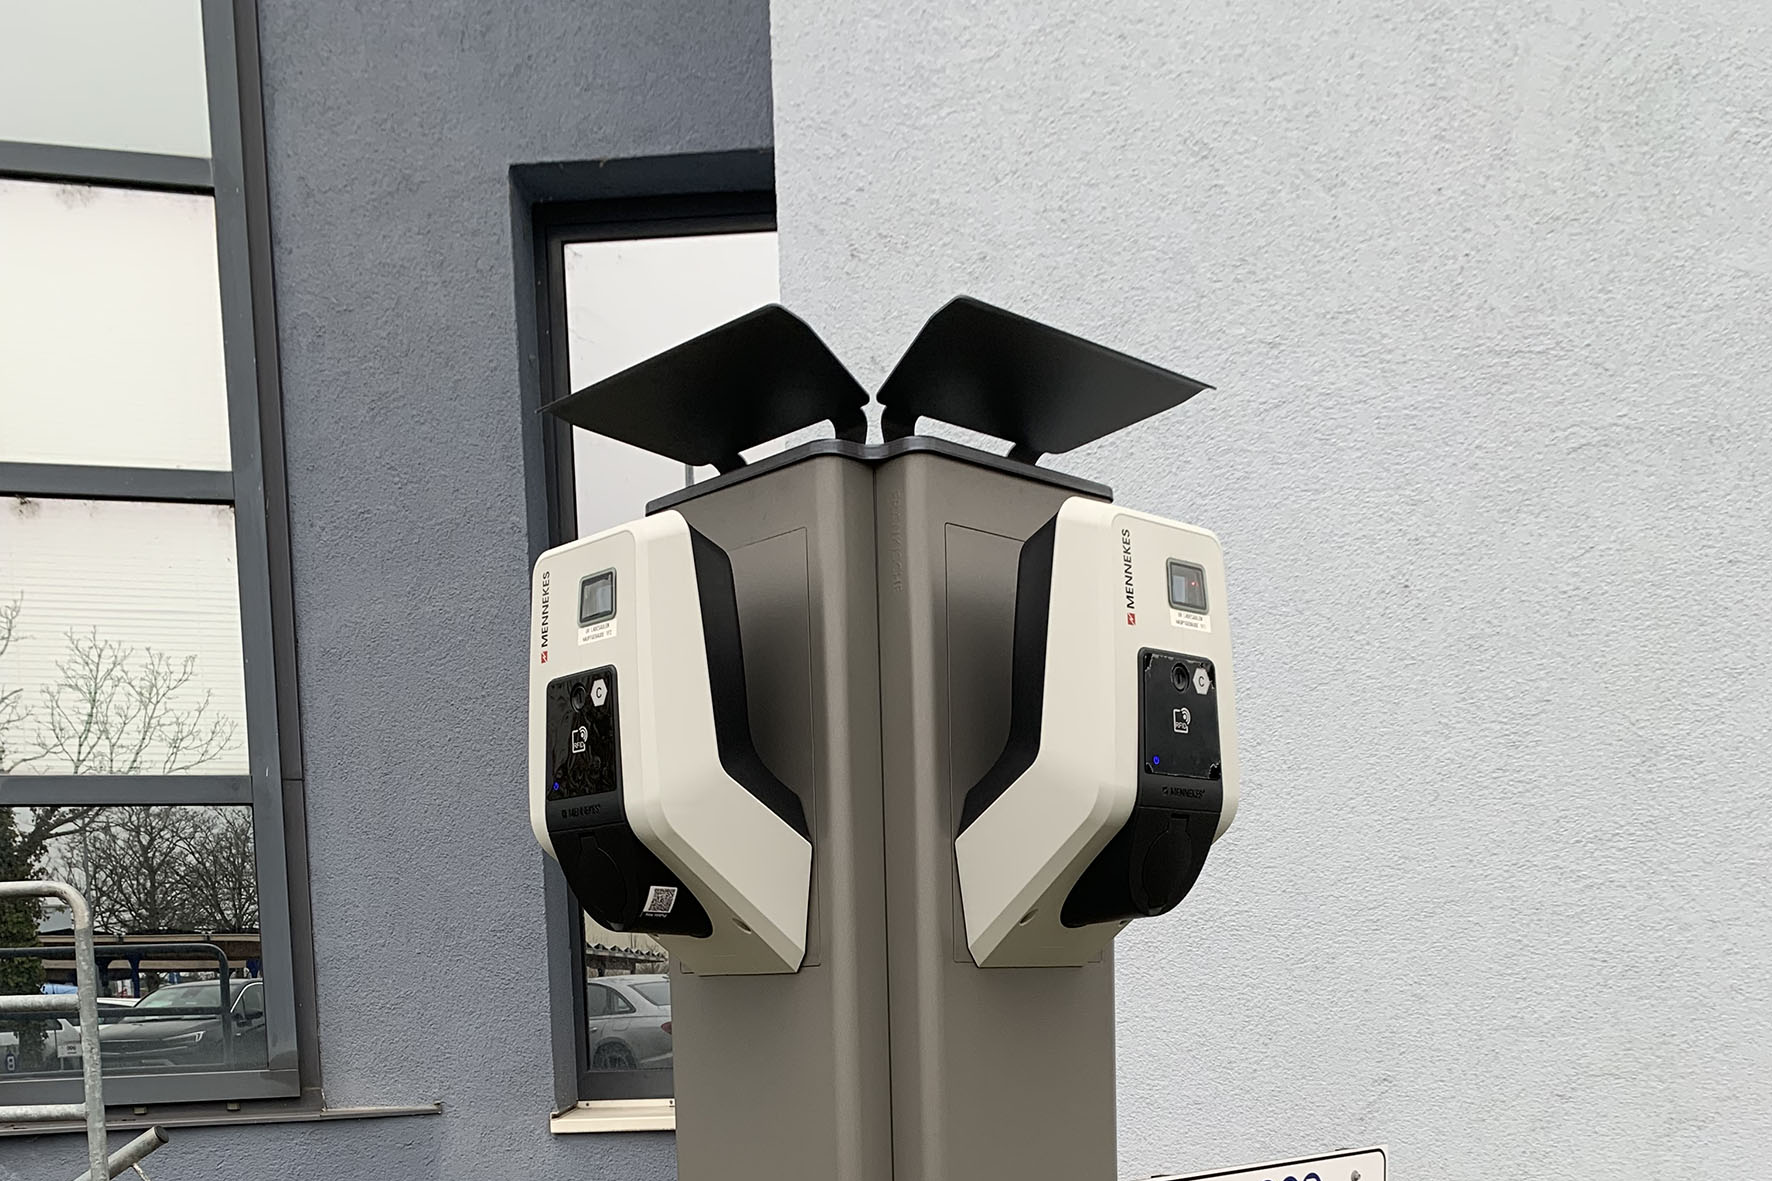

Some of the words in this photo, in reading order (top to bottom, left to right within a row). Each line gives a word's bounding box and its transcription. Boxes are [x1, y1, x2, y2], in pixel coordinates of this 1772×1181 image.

[1121, 528, 1135, 609] MENNEKES
[541, 571, 550, 648] MENNEKES
[595, 686, 602, 699] C
[1198, 675, 1205, 688] C
